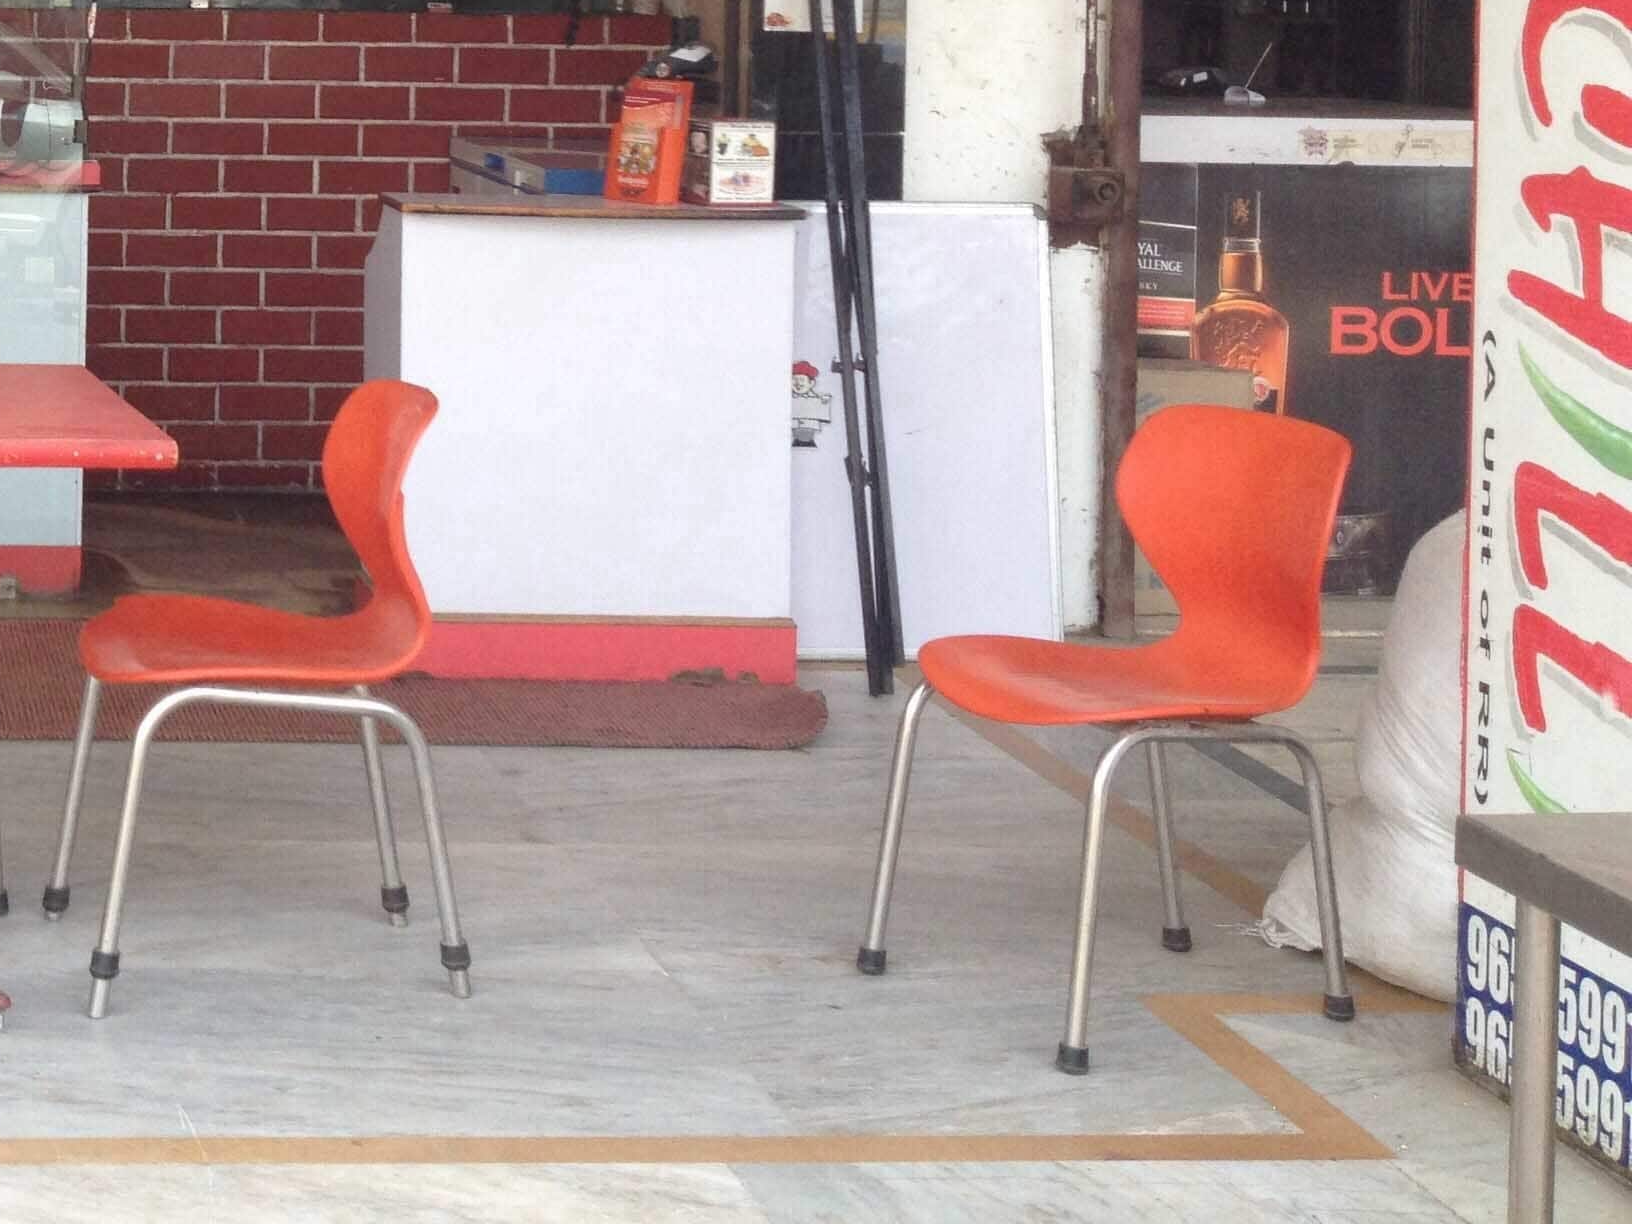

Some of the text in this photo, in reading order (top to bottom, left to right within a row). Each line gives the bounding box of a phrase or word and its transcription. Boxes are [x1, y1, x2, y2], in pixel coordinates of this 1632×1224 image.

[1381, 272, 1473, 301] LIVE
[1329, 306, 1473, 356] BOL
[1473, 329, 1497, 806] (A Unit of RR)
